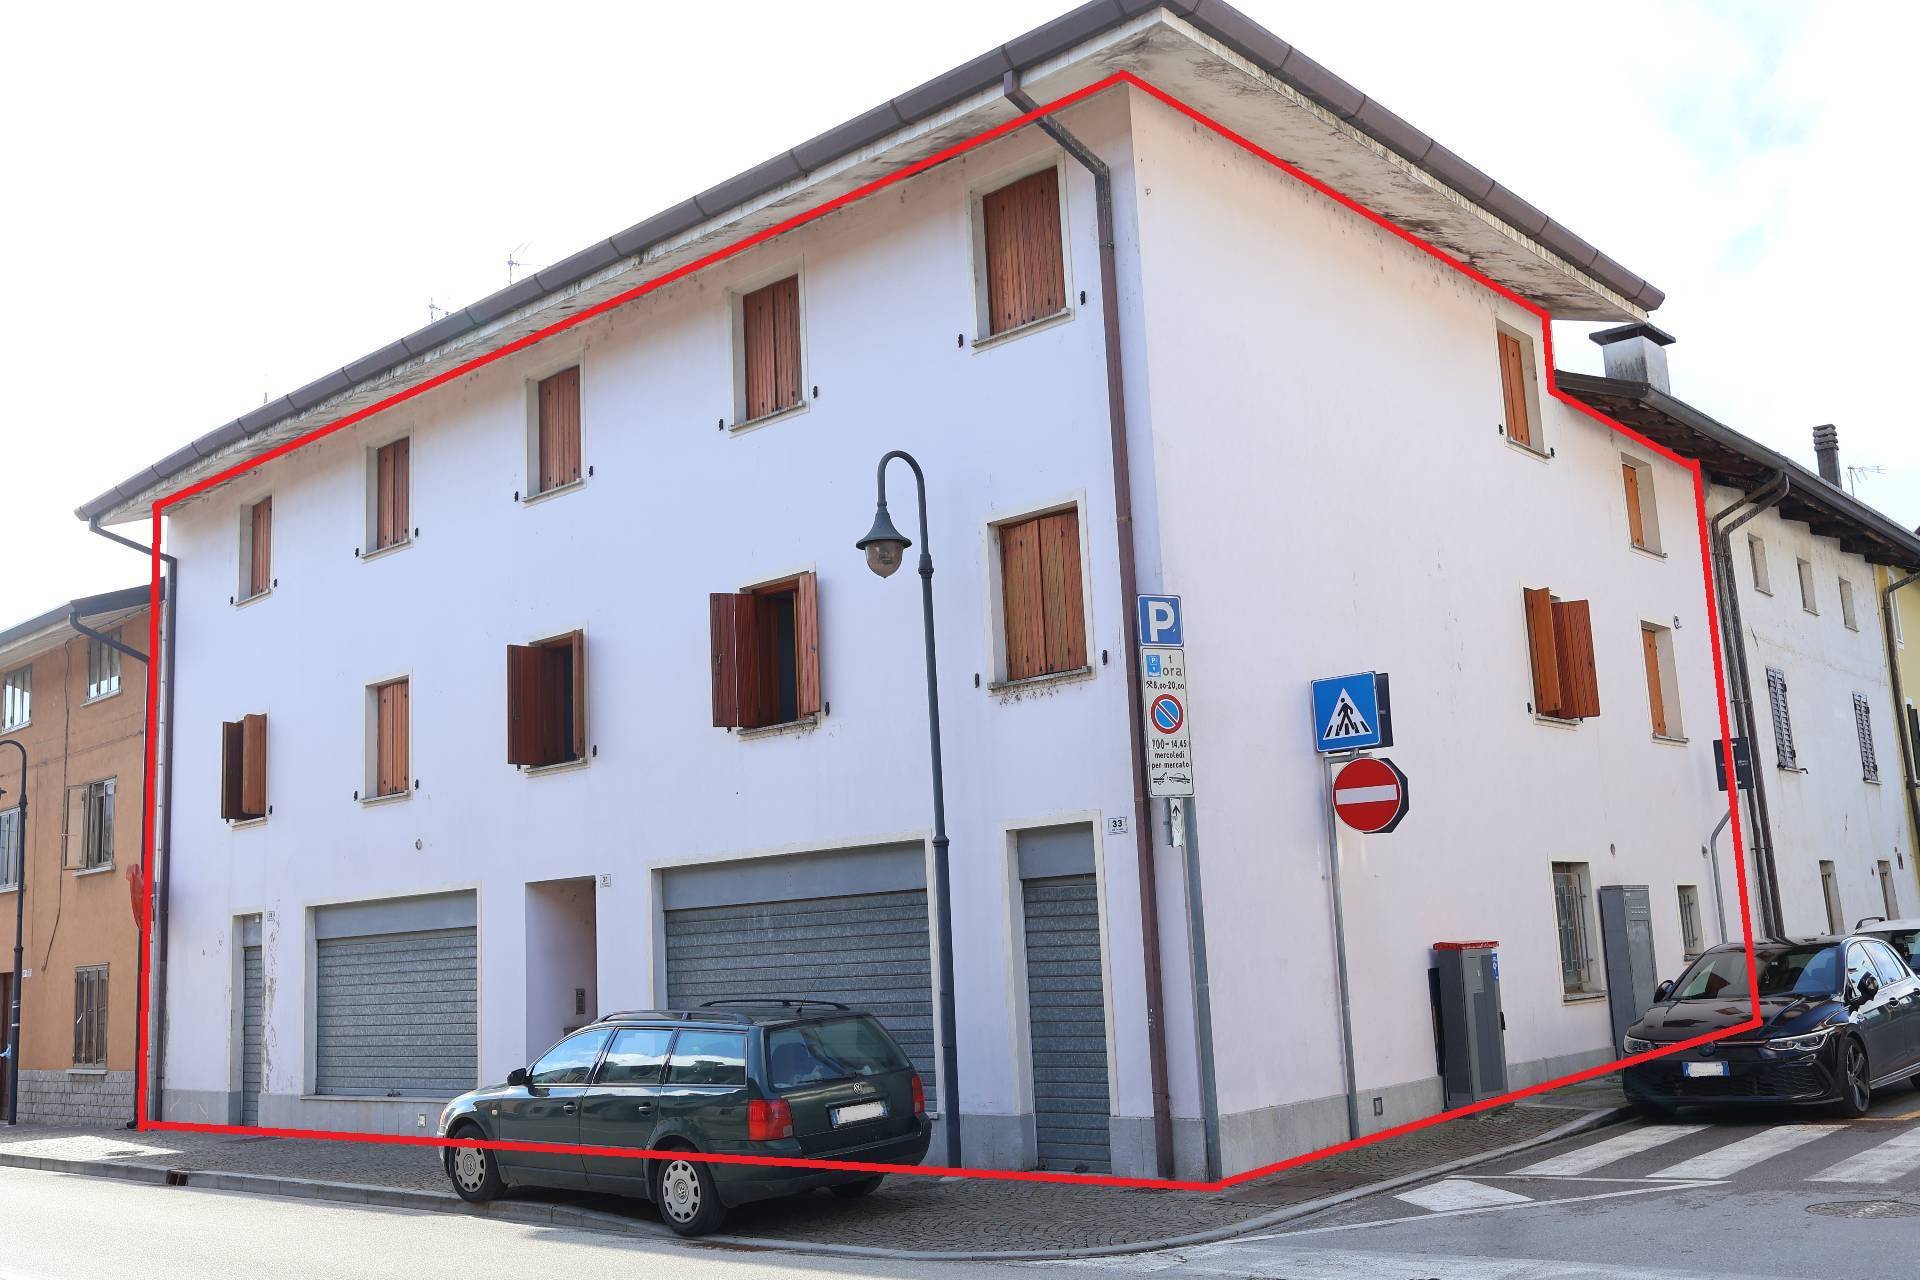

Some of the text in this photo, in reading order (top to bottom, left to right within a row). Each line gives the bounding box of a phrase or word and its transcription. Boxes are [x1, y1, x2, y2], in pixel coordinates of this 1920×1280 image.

[1148, 600, 1175, 641] P
[1168, 655, 1172, 663] 1
[1162, 666, 1182, 676] ora
[1152, 761, 1190, 770] per mercato
[1112, 819, 1123, 828] 33
